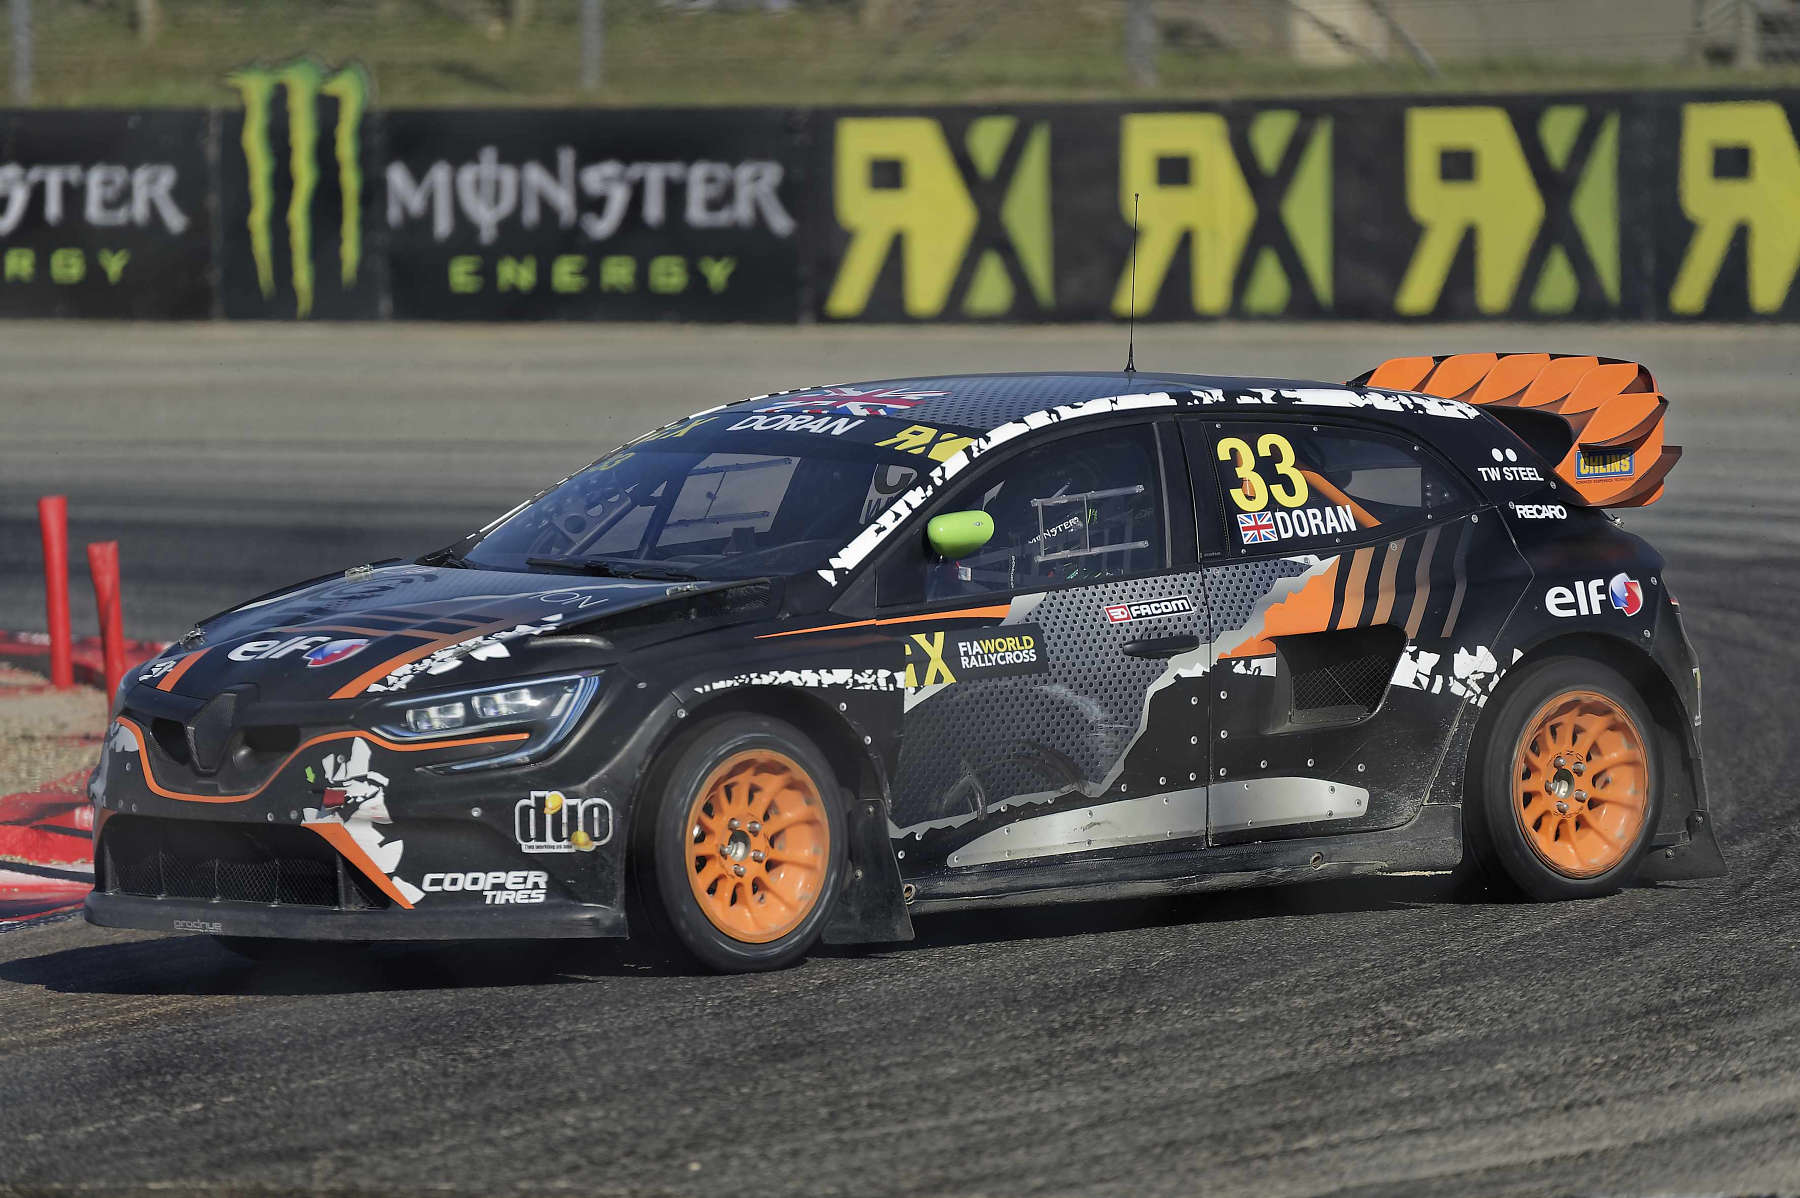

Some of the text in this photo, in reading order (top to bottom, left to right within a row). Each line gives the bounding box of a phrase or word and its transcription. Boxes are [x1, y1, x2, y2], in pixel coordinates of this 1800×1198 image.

[385, 145, 797, 245] MONSTER
[1109, 109, 1335, 317] RX
[1394, 104, 1623, 316] RX
[824, 114, 1056, 318] RX
[3, 246, 132, 286] RGY
[448, 254, 738, 294] ENERGY
[726, 414, 866, 436] DORAN
[1216, 433, 1309, 512] 33
[1477, 466, 1545, 482] TW STEEL
[1275, 504, 1357, 540] DORAN
[1515, 504, 1568, 520] RECARO
[1130, 599, 1190, 618] FACOM
[1544, 578, 1607, 618] elf
[227, 635, 332, 662] elf
[961, 649, 1037, 669] RALLYCROSS
[422, 871, 548, 892] COOPER
[483, 889, 547, 905] TIRES
